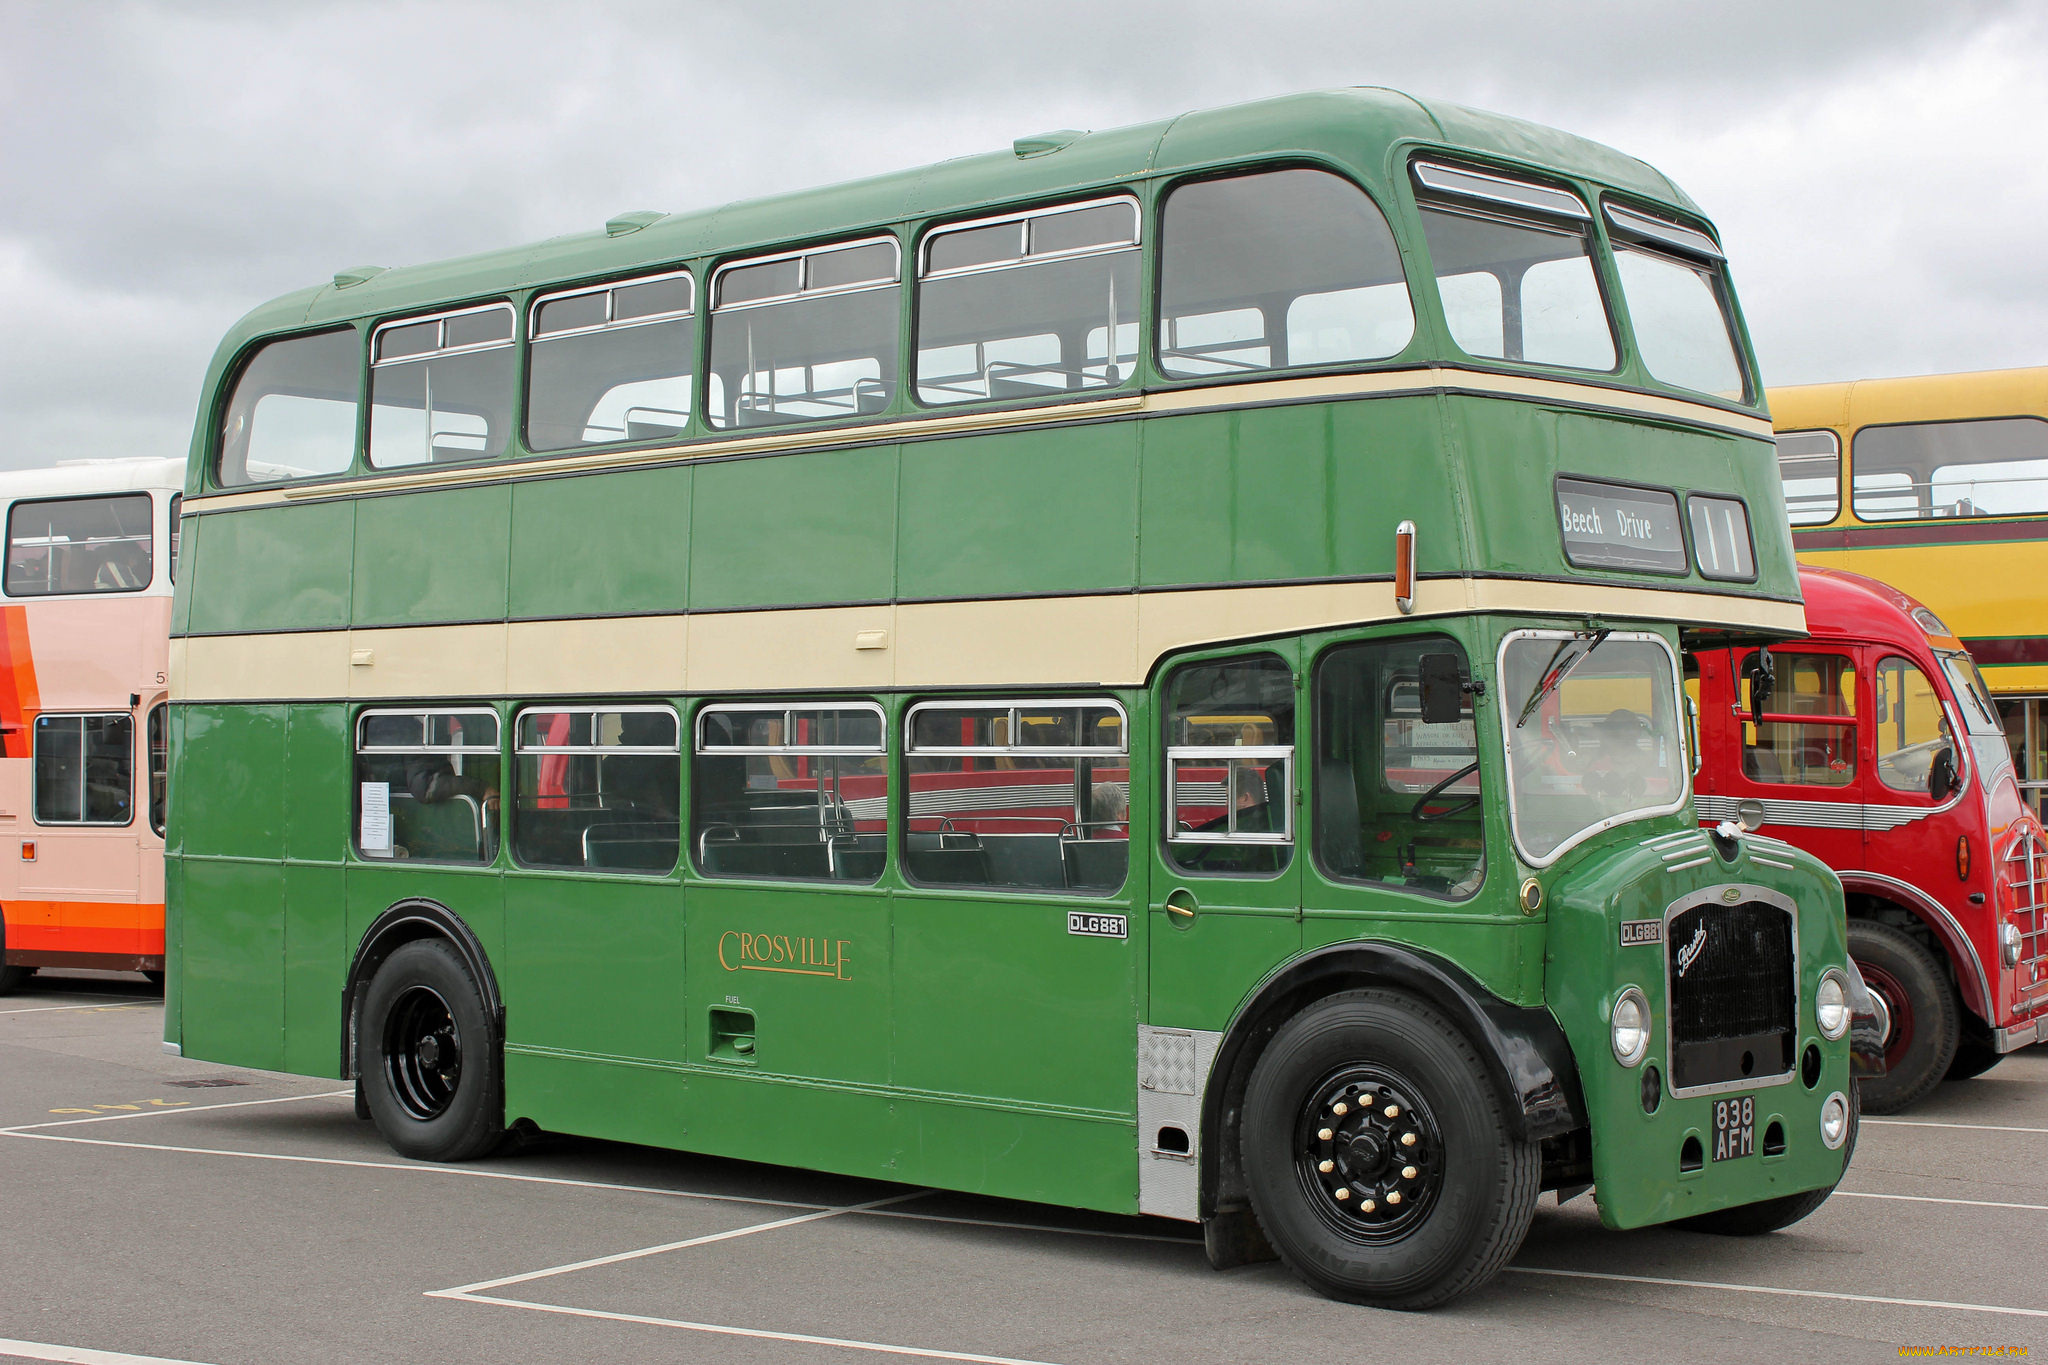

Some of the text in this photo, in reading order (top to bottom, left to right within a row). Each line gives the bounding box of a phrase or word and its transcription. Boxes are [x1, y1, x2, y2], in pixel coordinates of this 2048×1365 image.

[1562, 504, 1652, 540] Beech Drive
[1689, 504, 1740, 573] 11
[1070, 915, 1125, 934] DLG881
[1623, 923, 1661, 942] DLG881
[718, 930, 852, 981] CROSVILLE
[725, 995, 740, 1004] FUEL
[1716, 1097, 1753, 1130] 838
[1716, 1126, 1754, 1160] AFM
